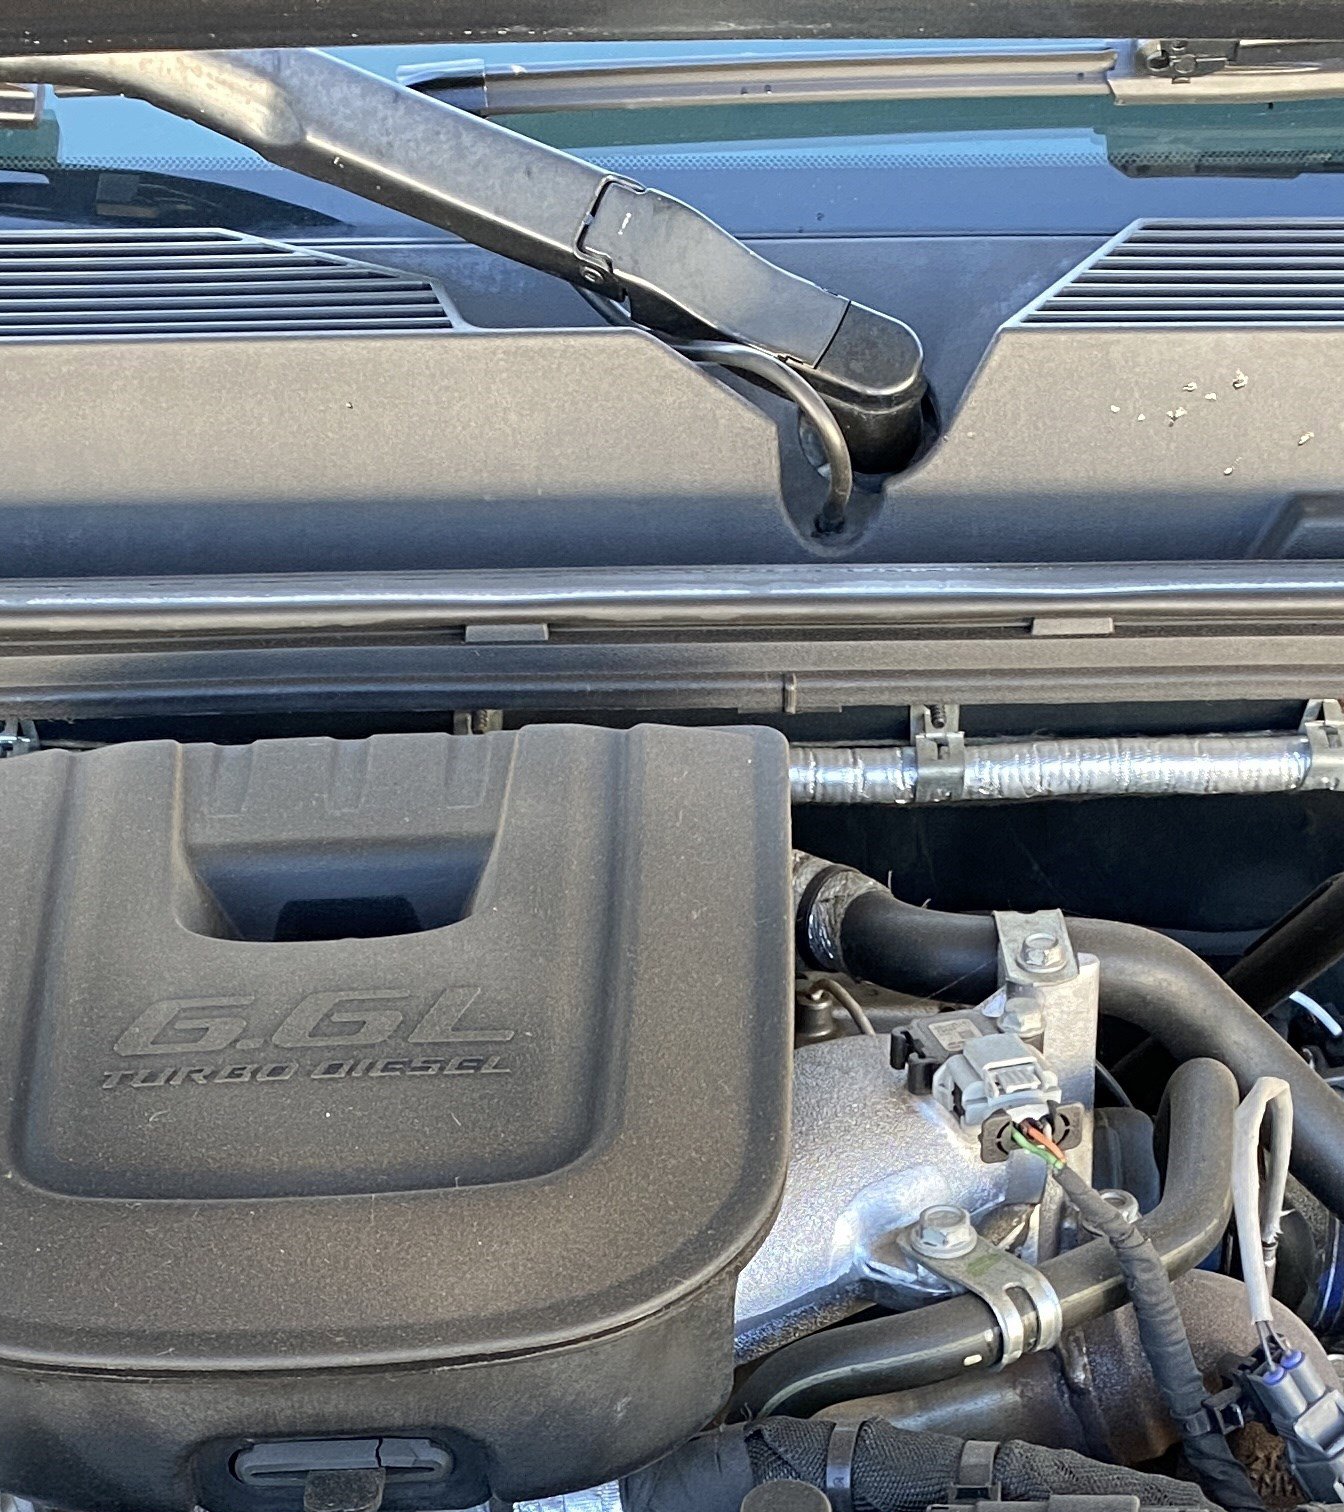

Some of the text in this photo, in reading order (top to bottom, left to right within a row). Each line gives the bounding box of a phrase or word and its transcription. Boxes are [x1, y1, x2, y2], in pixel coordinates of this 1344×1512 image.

[112, 986, 515, 1057] 6.6L
[102, 1055, 512, 1089] TURBO DIESEL
